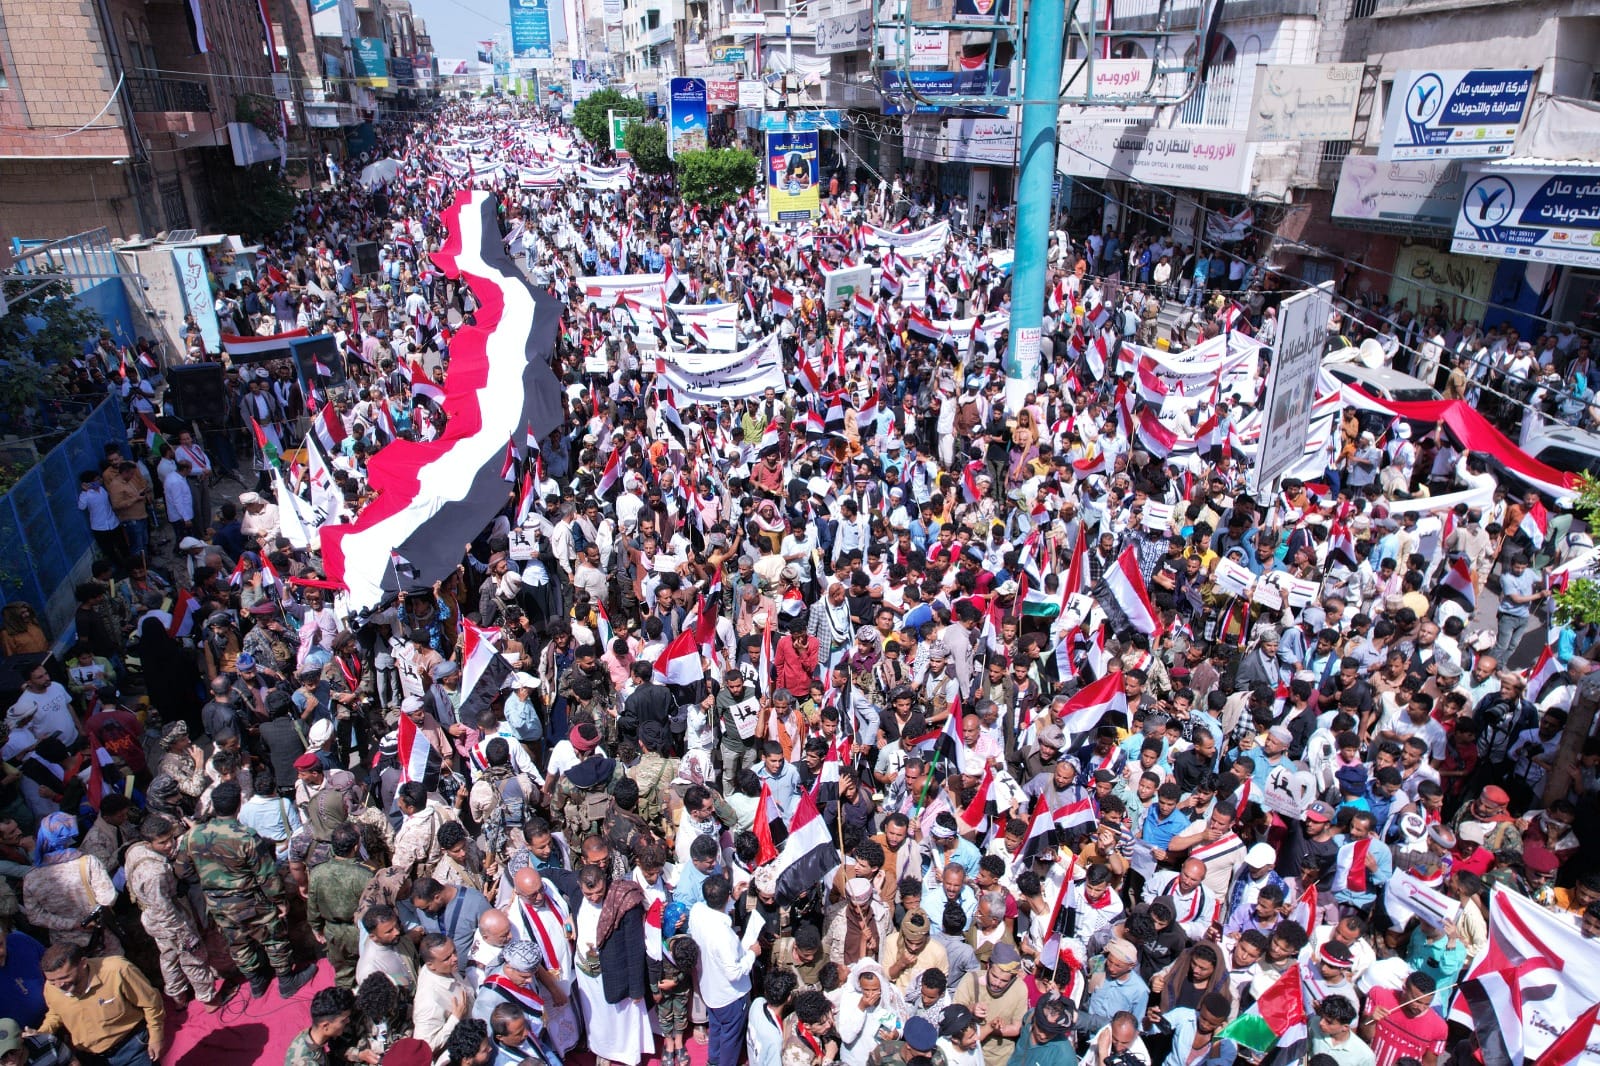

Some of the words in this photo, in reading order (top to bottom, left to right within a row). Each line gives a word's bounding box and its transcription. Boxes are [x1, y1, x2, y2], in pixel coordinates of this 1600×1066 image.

[1097, 67, 1140, 85] الأوروبي
[1455, 82, 1471, 96] مال
[1471, 82, 1505, 97] اليوسفي
[1505, 80, 1528, 97] شركة
[1451, 102, 1491, 116] والتحويلات
[1491, 101, 1521, 115] للصرافة
[1113, 137, 1154, 156] والسمعيات
[1155, 139, 1190, 157] للنظارات
[1193, 142, 1236, 160] الأوروبي
[1151, 161, 1169, 169] OPTICAL
[1388, 162, 1460, 188] الواحة
[1546, 181, 1573, 197] مال
[1411, 258, 1476, 294] الواحة
